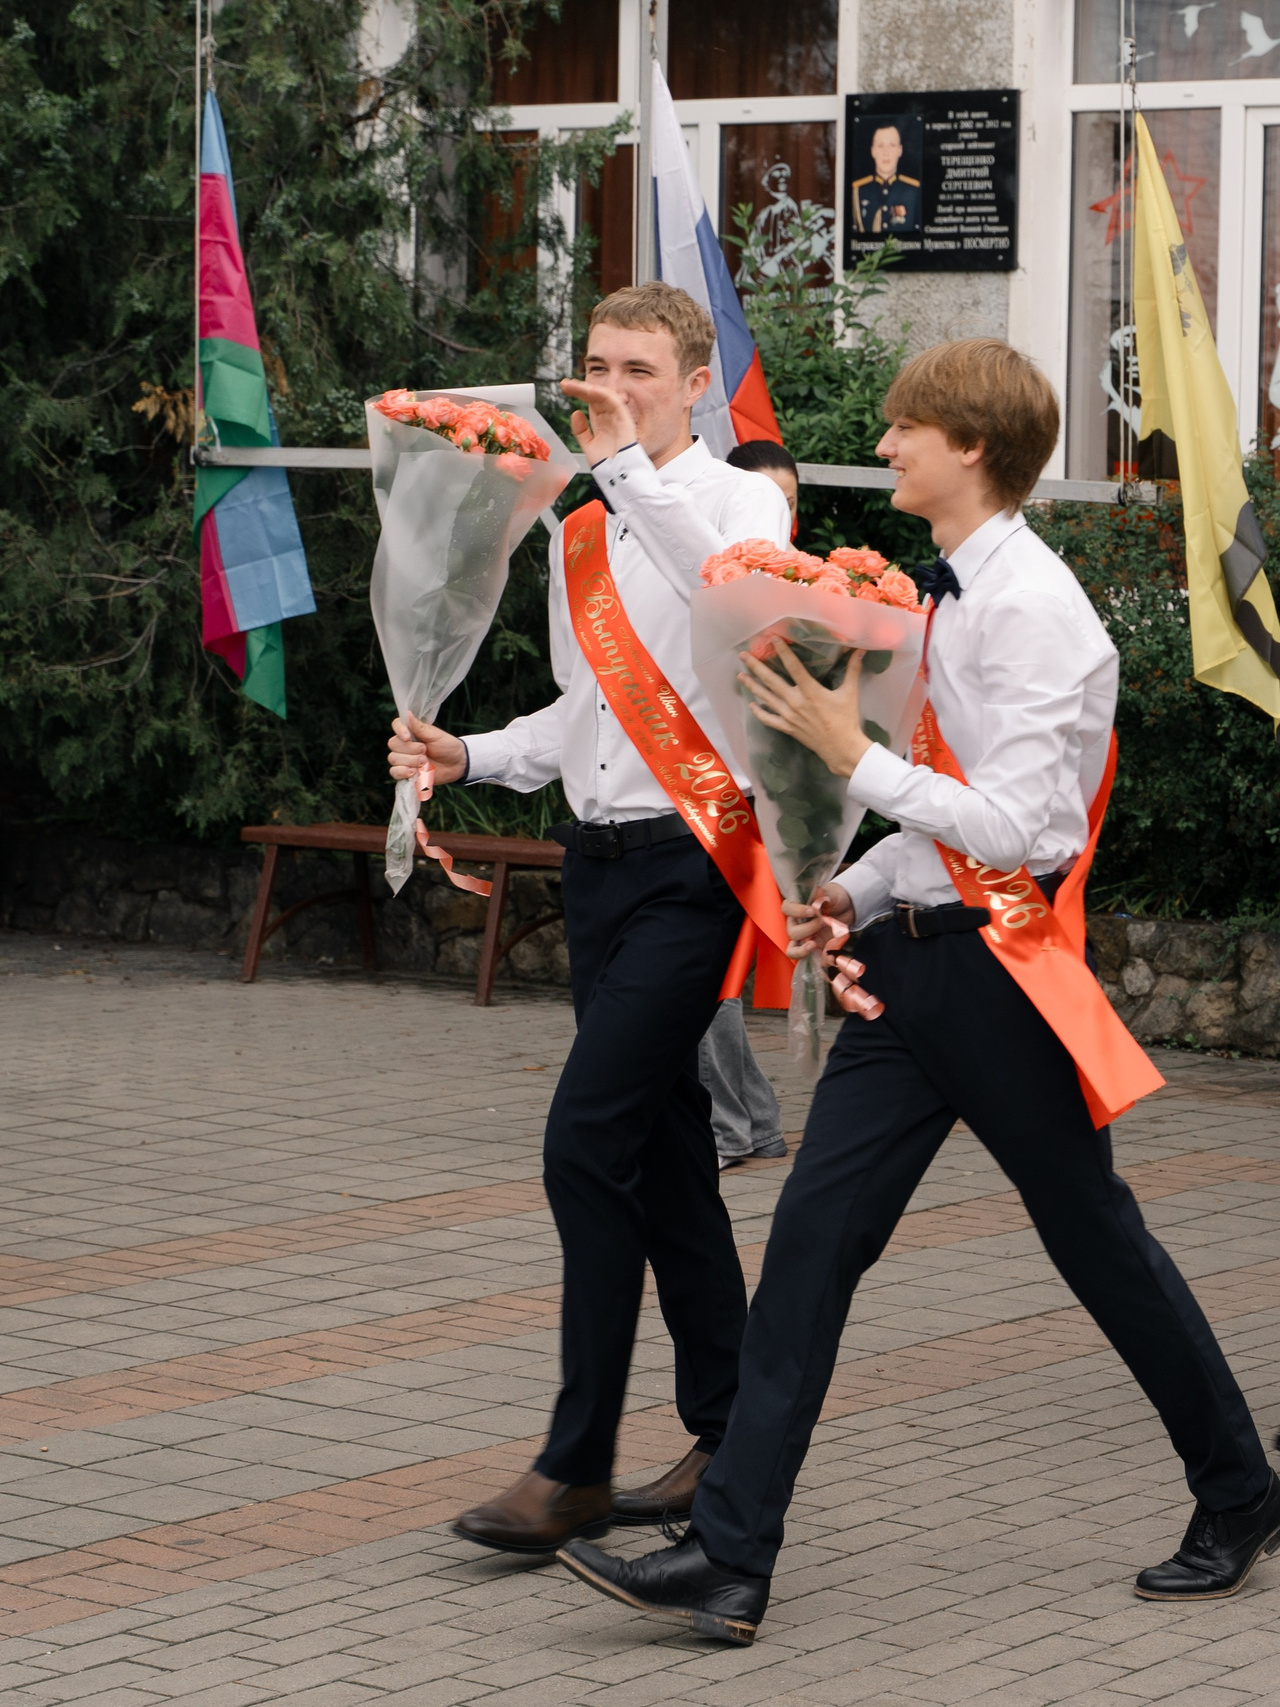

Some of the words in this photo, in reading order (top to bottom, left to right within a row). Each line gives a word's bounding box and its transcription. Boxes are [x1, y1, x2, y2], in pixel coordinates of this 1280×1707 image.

[941, 155, 996, 166] ТЕРЕЩЕНКО
[945, 166, 989, 179] ДМИТРИЙ
[941, 180, 993, 191] СЕРГЕЕВИЧ
[963, 236, 1010, 249] ПОСМЕРТНО
[580, 571, 679, 751] Выпускник
[673, 751, 750, 835] 2026
[656, 684, 679, 718] Иван
